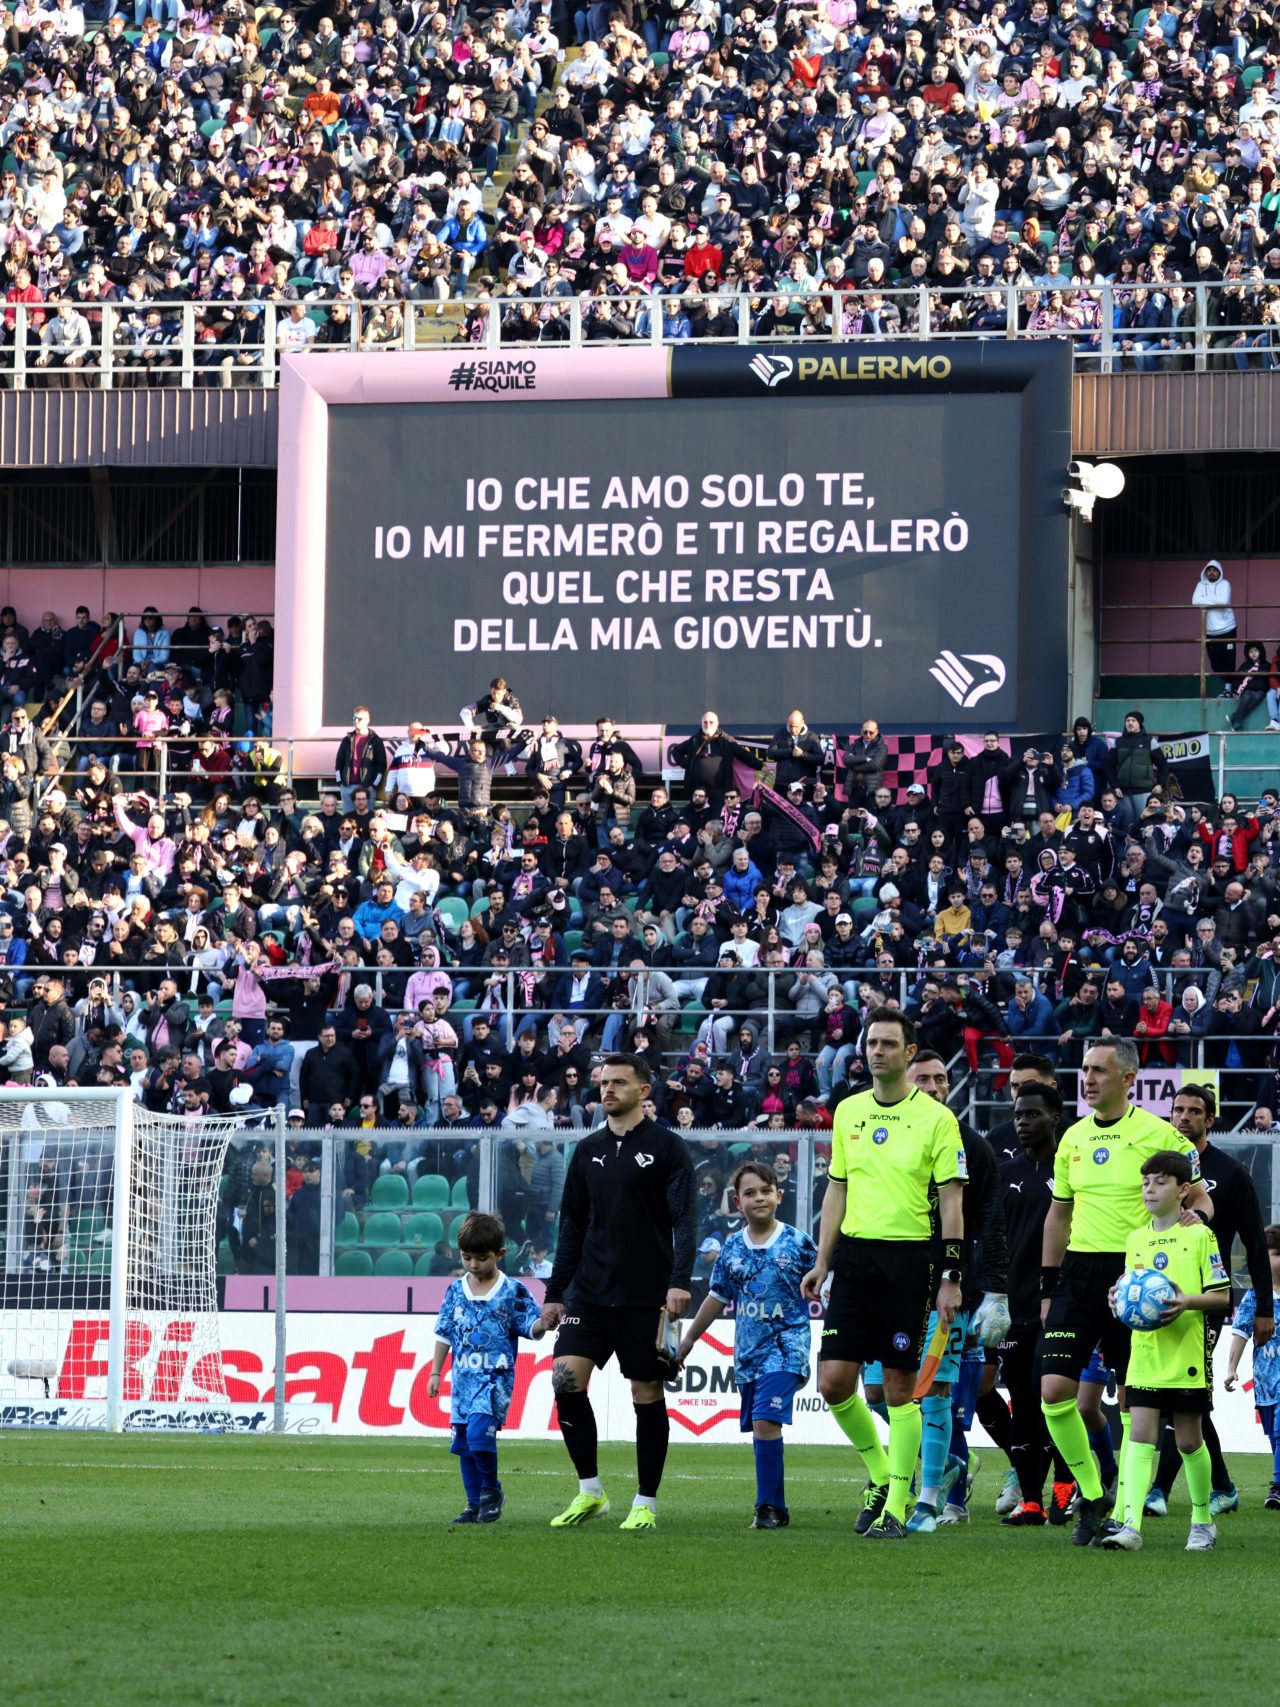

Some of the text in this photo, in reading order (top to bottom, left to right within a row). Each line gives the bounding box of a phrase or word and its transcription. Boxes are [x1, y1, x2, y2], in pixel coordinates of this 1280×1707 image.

[448, 360, 536, 391] #SIAMO
[798, 355, 952, 381] PALERMO
[474, 375, 536, 393] AQUILE
[466, 472, 875, 511] IO CHE AMO SOLO TE,
[374, 511, 969, 559] IO MI FERMERÒ E TI REGALERÒ
[502, 568, 834, 606] QUEL CHE RESTA
[453, 608, 883, 652] DELLA MIA GIOVENTÙ.
[737, 1302, 784, 1319] MOLA
[456, 1352, 508, 1370] MOLA
[678, 1398, 700, 1406] SINCE
